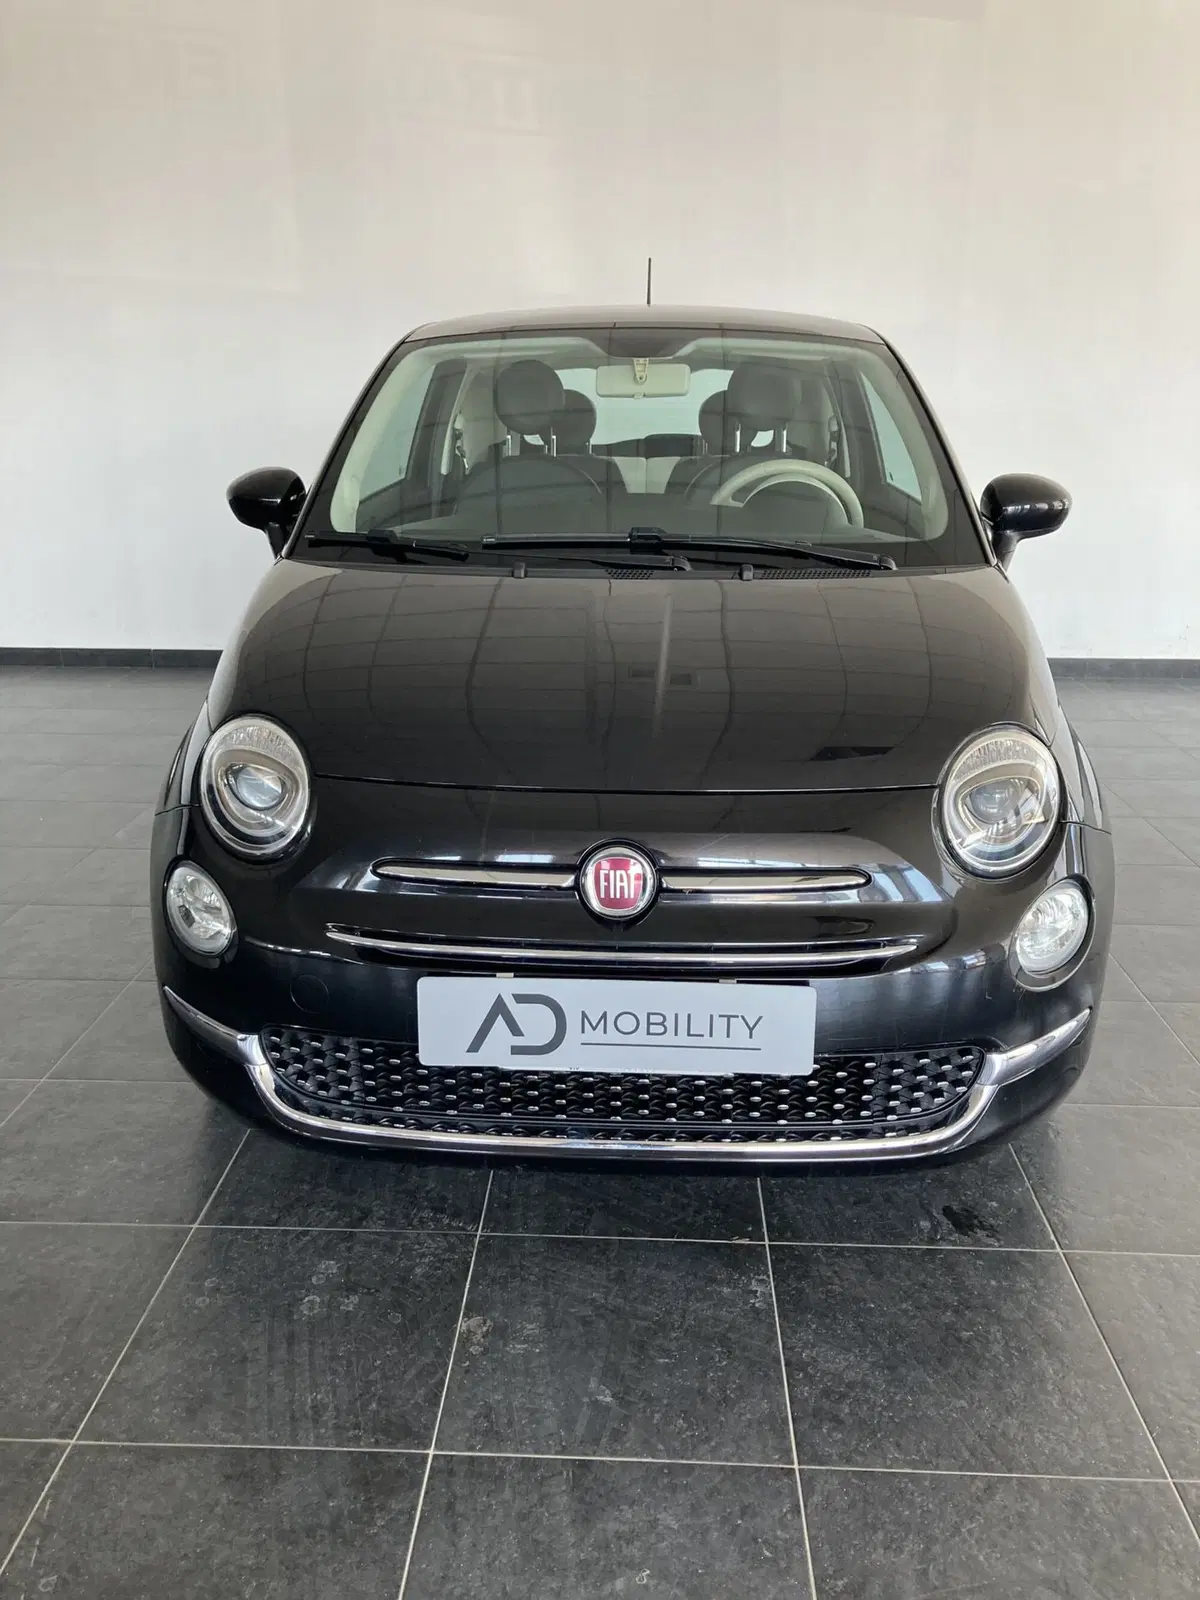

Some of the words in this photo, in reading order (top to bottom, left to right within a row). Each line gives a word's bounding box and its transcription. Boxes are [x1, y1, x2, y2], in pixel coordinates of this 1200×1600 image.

[600, 869, 643, 899] FIAT
[466, 993, 567, 1055] AD
[580, 1010, 764, 1040] MOBILITY
